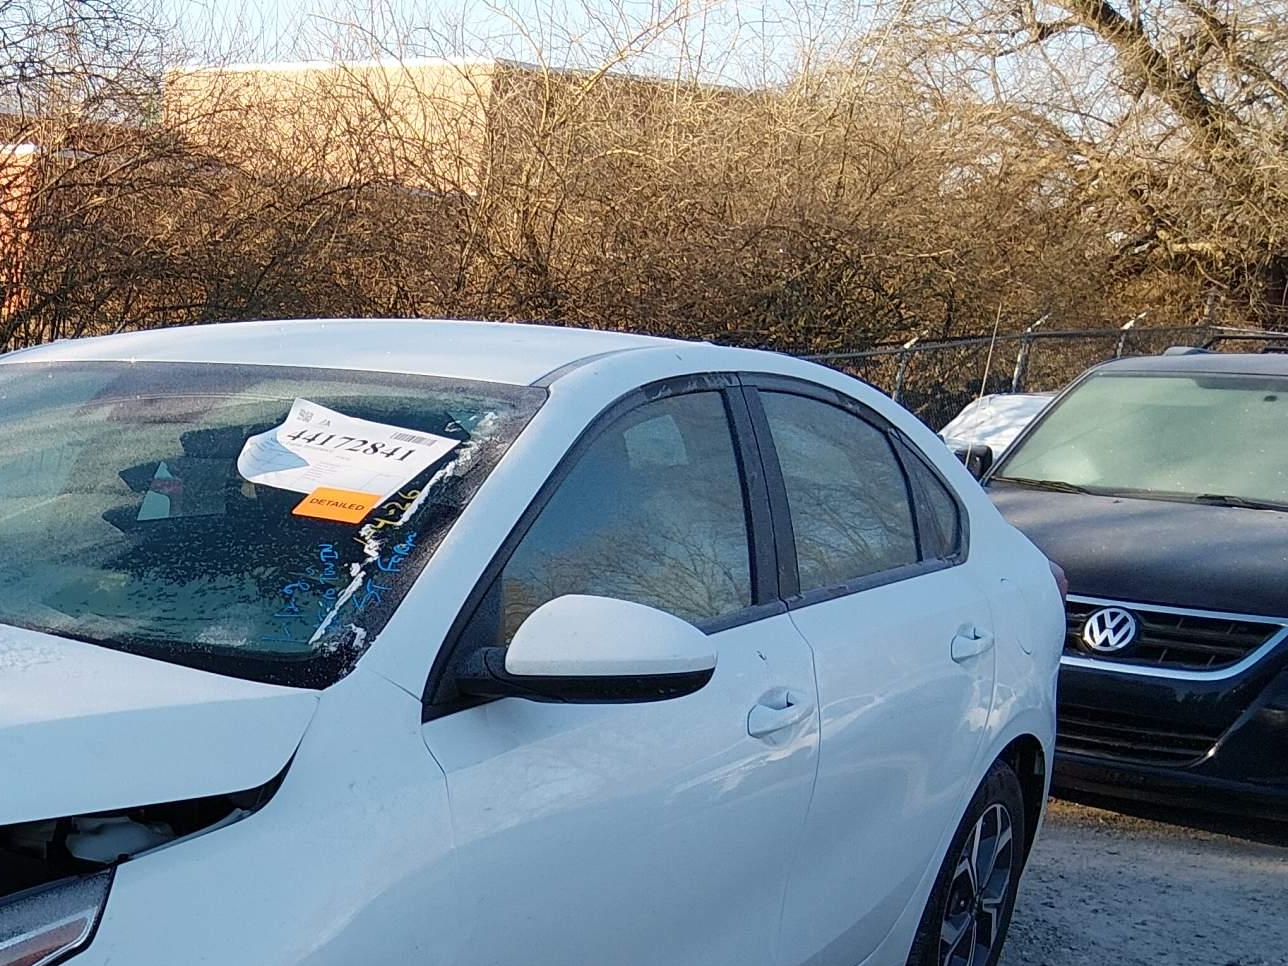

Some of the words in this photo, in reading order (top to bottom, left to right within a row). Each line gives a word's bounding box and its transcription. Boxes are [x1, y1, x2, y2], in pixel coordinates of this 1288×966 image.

[287, 429, 416, 462] 44172841
[309, 497, 365, 512] DETAILED
[1084, 607, 1137, 651] VW
